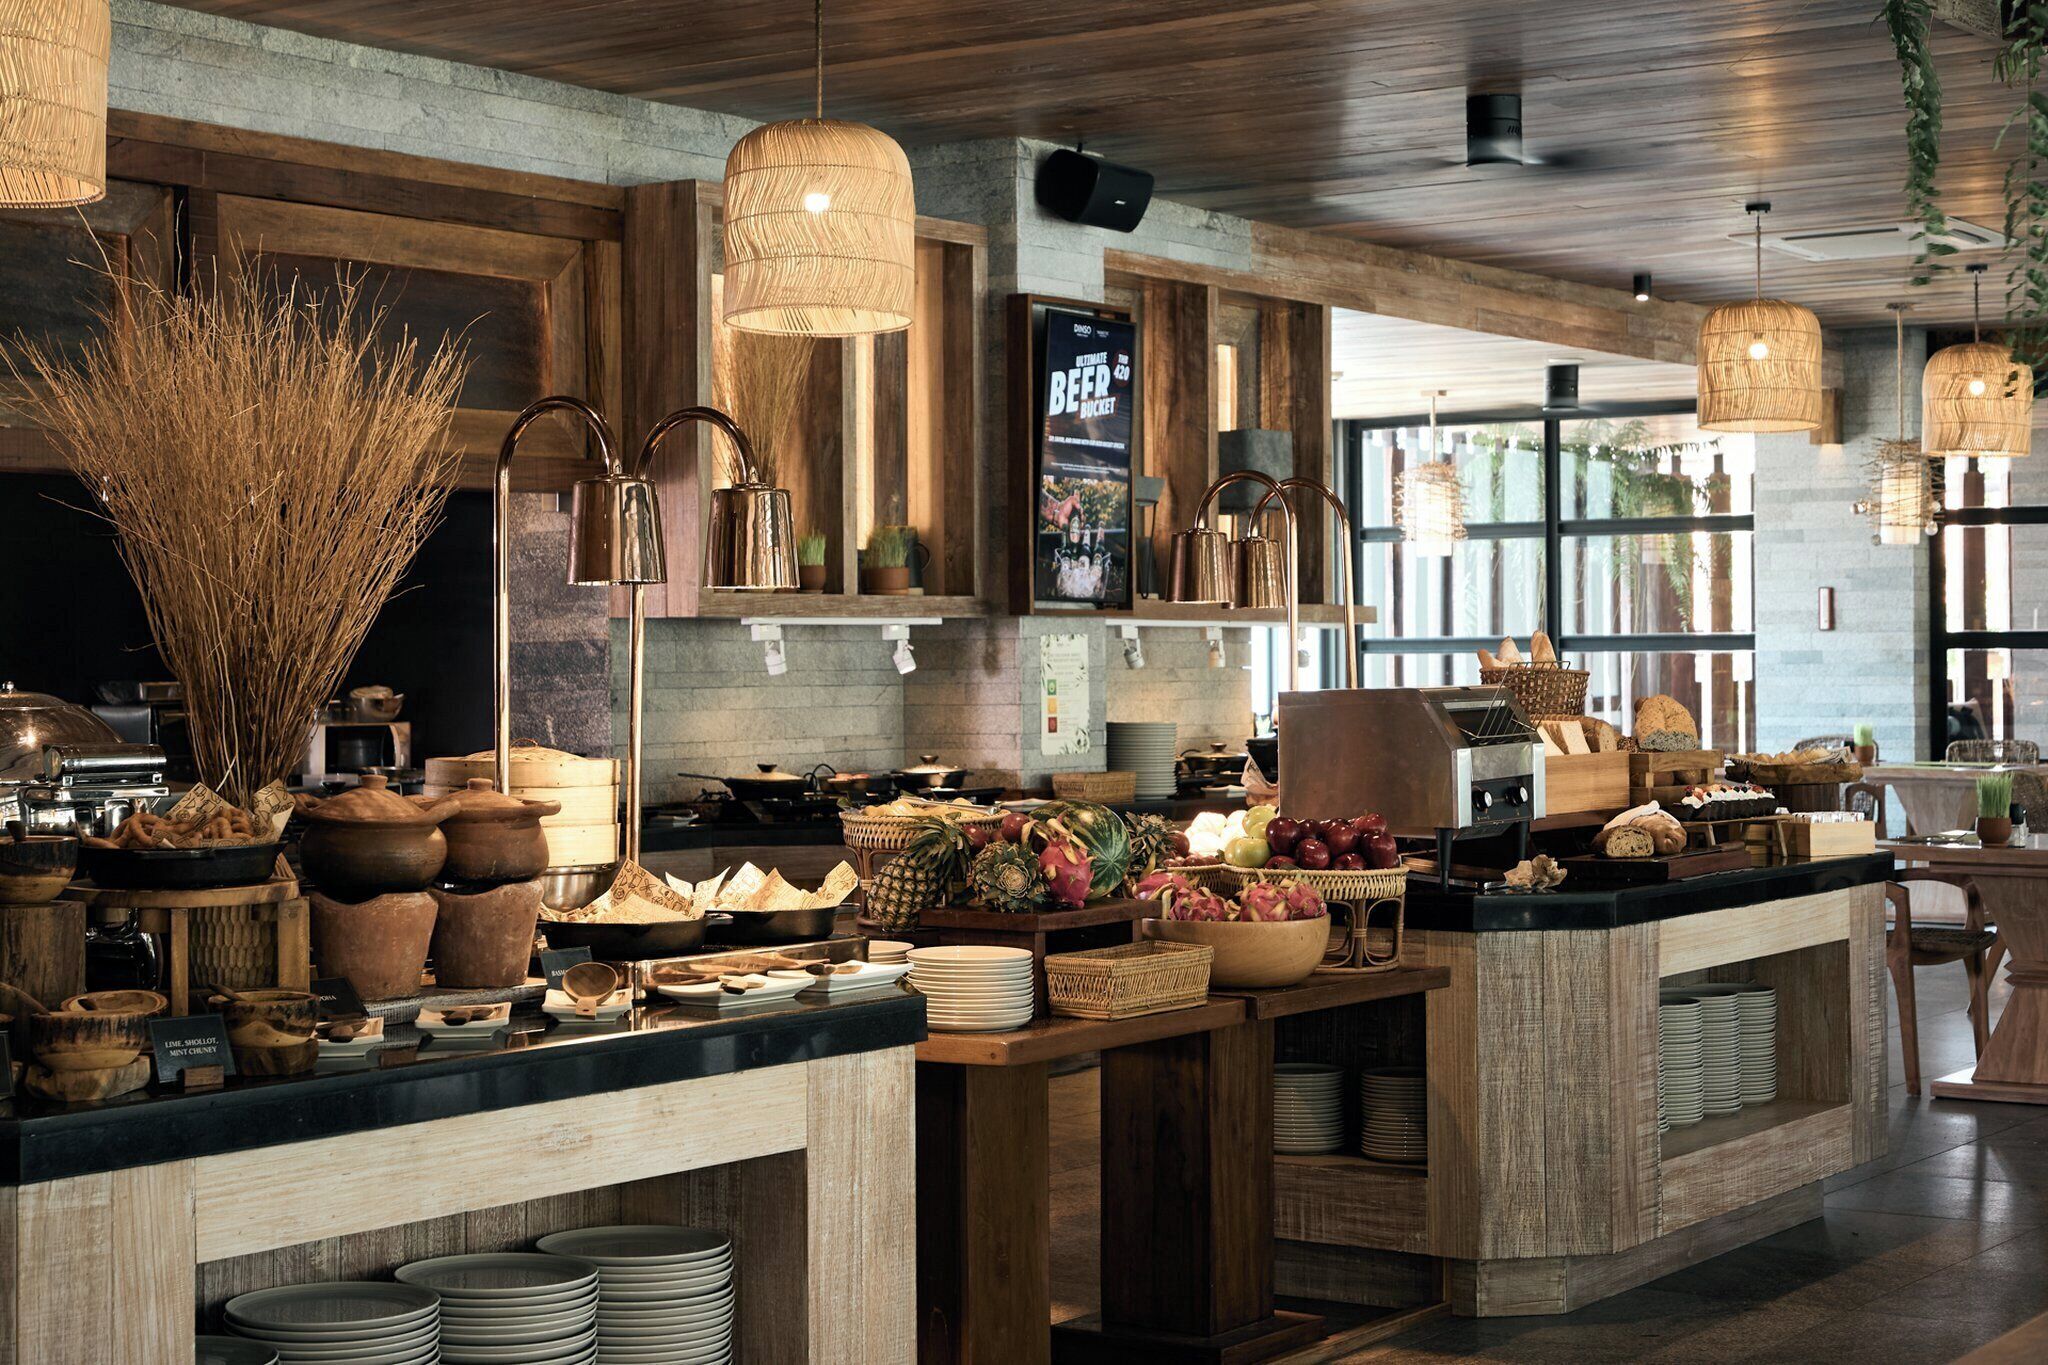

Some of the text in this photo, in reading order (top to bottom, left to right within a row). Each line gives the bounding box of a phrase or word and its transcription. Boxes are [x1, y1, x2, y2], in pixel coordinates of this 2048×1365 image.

[1076, 352, 1108, 367] ULTIMATE
[1113, 364, 1131, 381] 420
[1049, 364, 1111, 416] BEER
[1080, 397, 1116, 419] BUCKET
[169, 1046, 217, 1057] MINT CHUNEY
